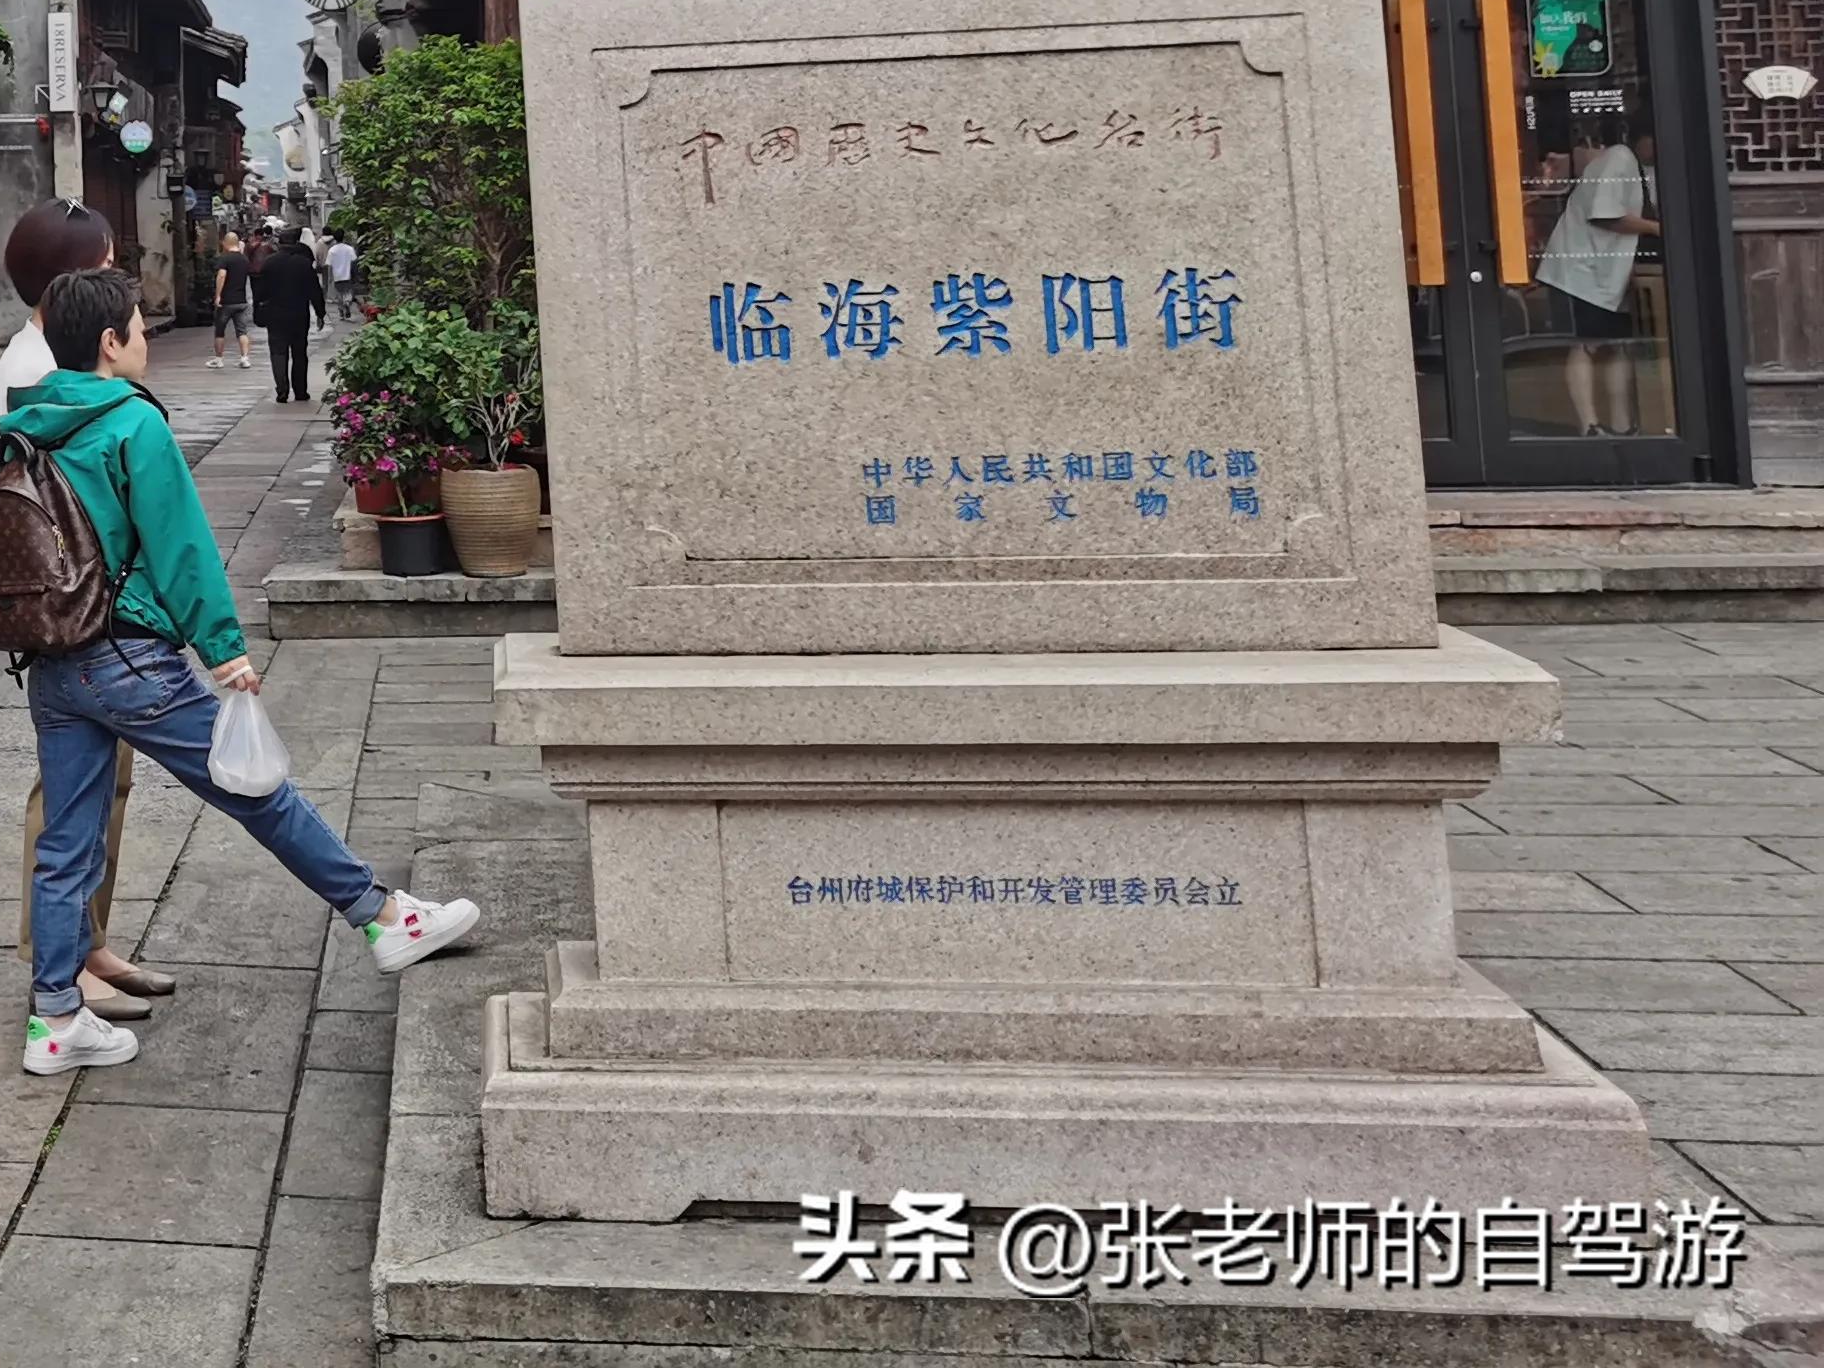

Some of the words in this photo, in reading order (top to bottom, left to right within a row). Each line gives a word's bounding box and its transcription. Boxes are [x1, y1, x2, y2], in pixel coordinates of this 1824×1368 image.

[708, 267, 1243, 366] 临海紫阳街
[862, 448, 1259, 488] 中华人民共和国文化部
[866, 487, 1261, 526] 国家文物局
[787, 874, 1243, 906] 台州府城保护和开发管理委员会立
